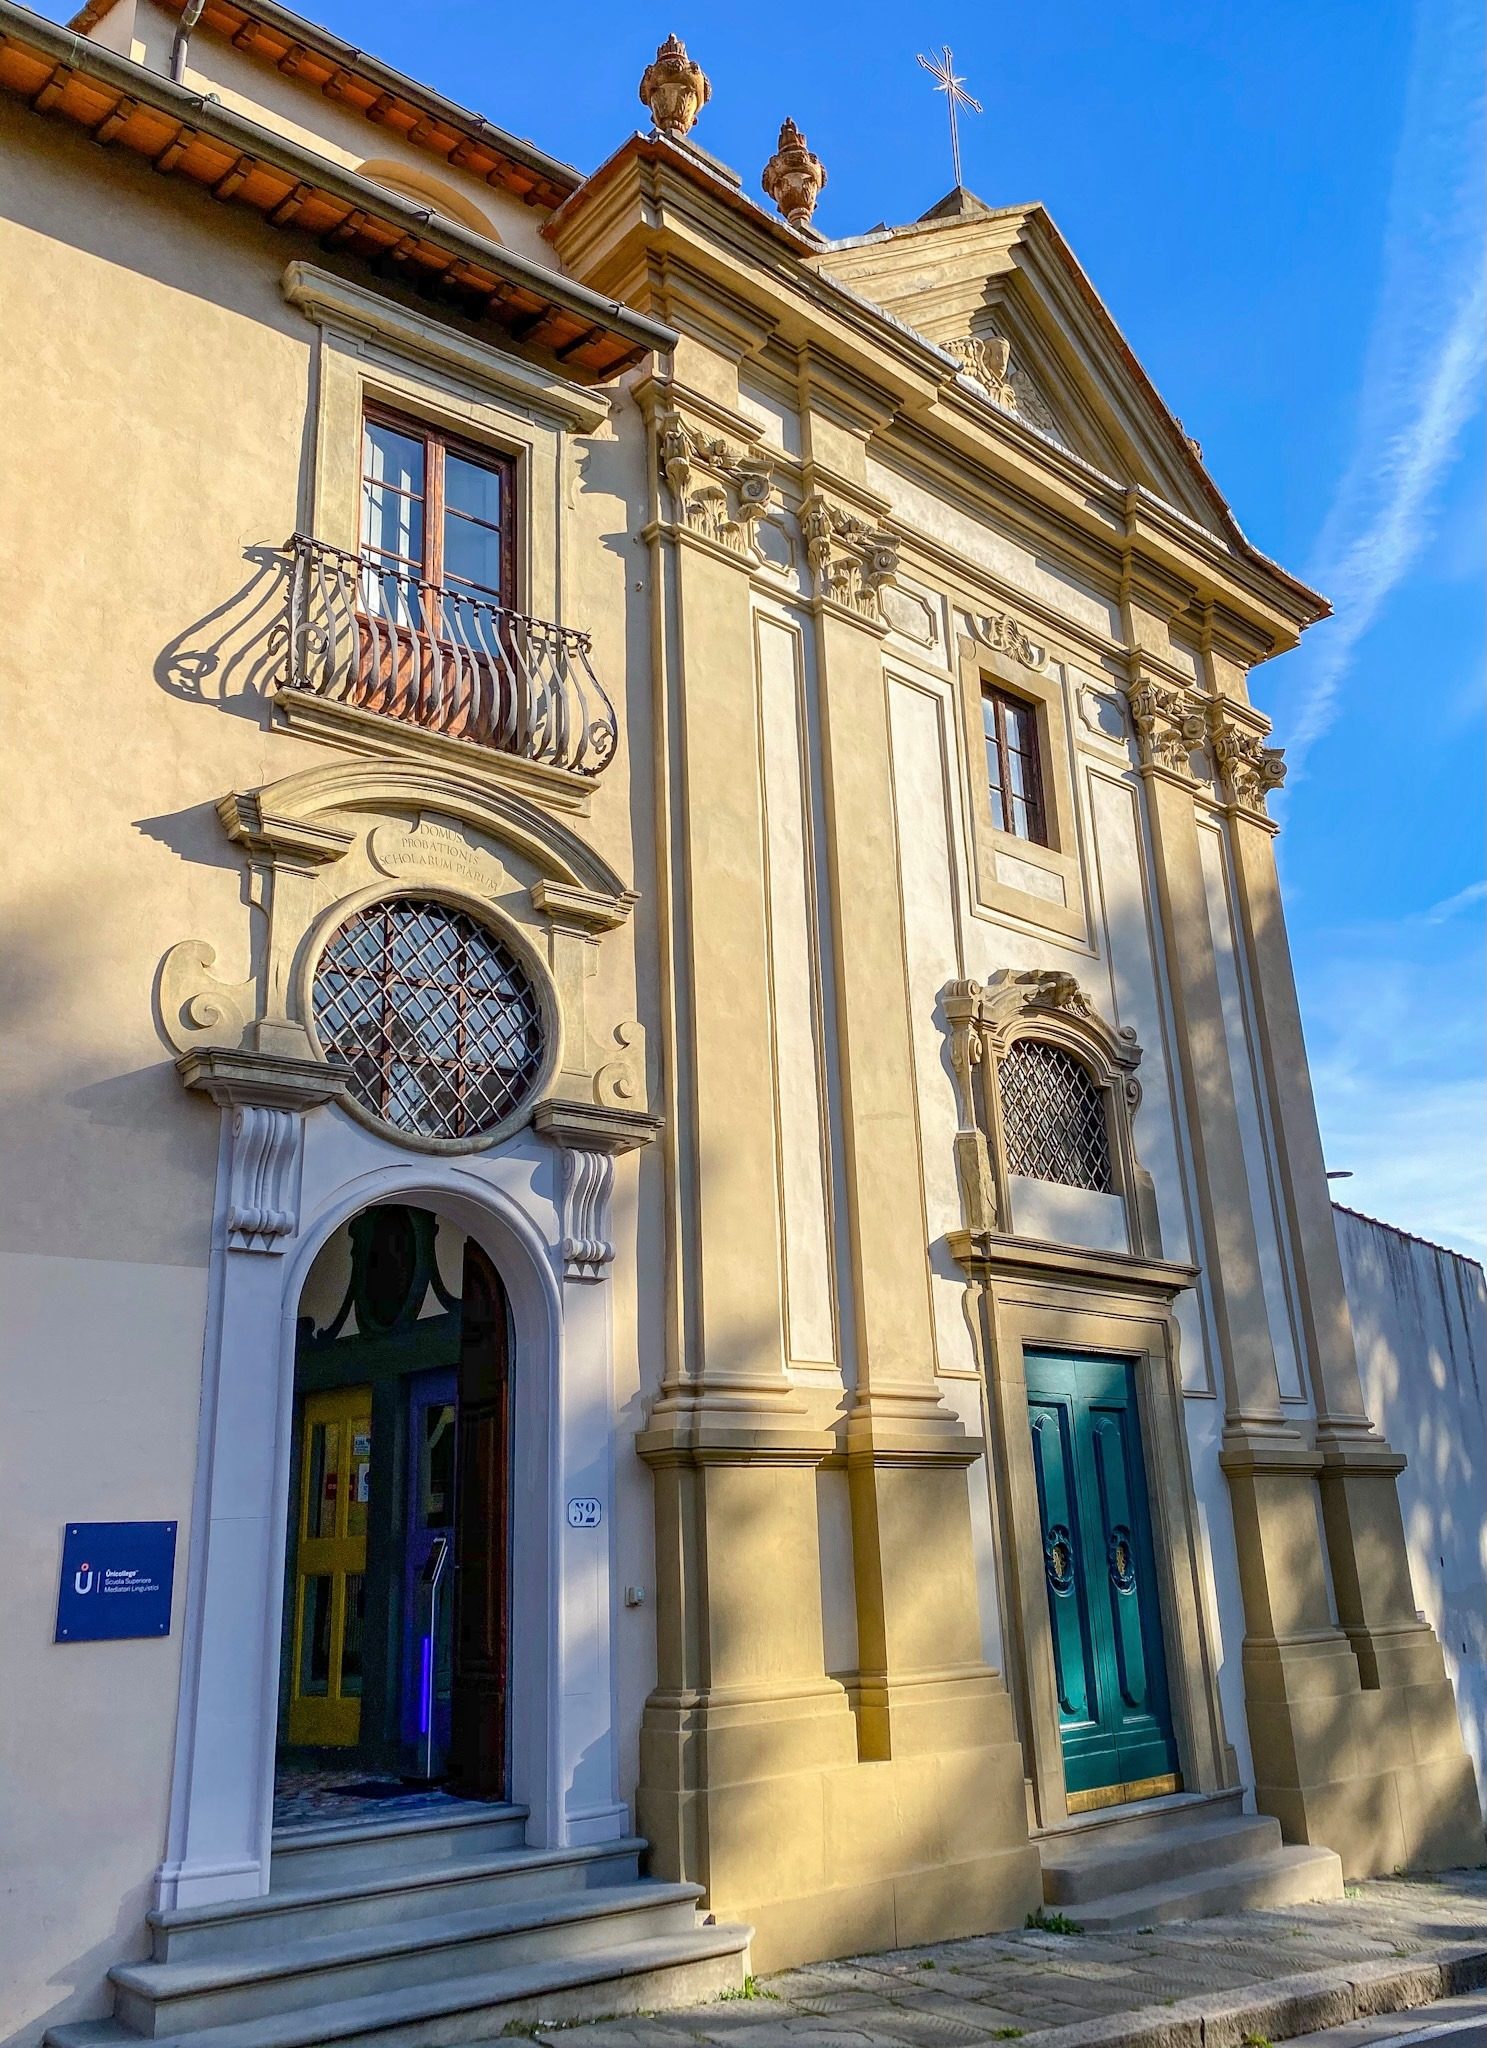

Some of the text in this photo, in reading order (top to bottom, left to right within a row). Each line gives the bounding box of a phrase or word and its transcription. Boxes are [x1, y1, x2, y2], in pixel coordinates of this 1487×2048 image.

[420, 823, 463, 843] DOMUS
[401, 838, 479, 864] PROBATIONIS
[379, 853, 498, 892] SCHOLARUM PIARUM
[573, 1502, 595, 1523] 52
